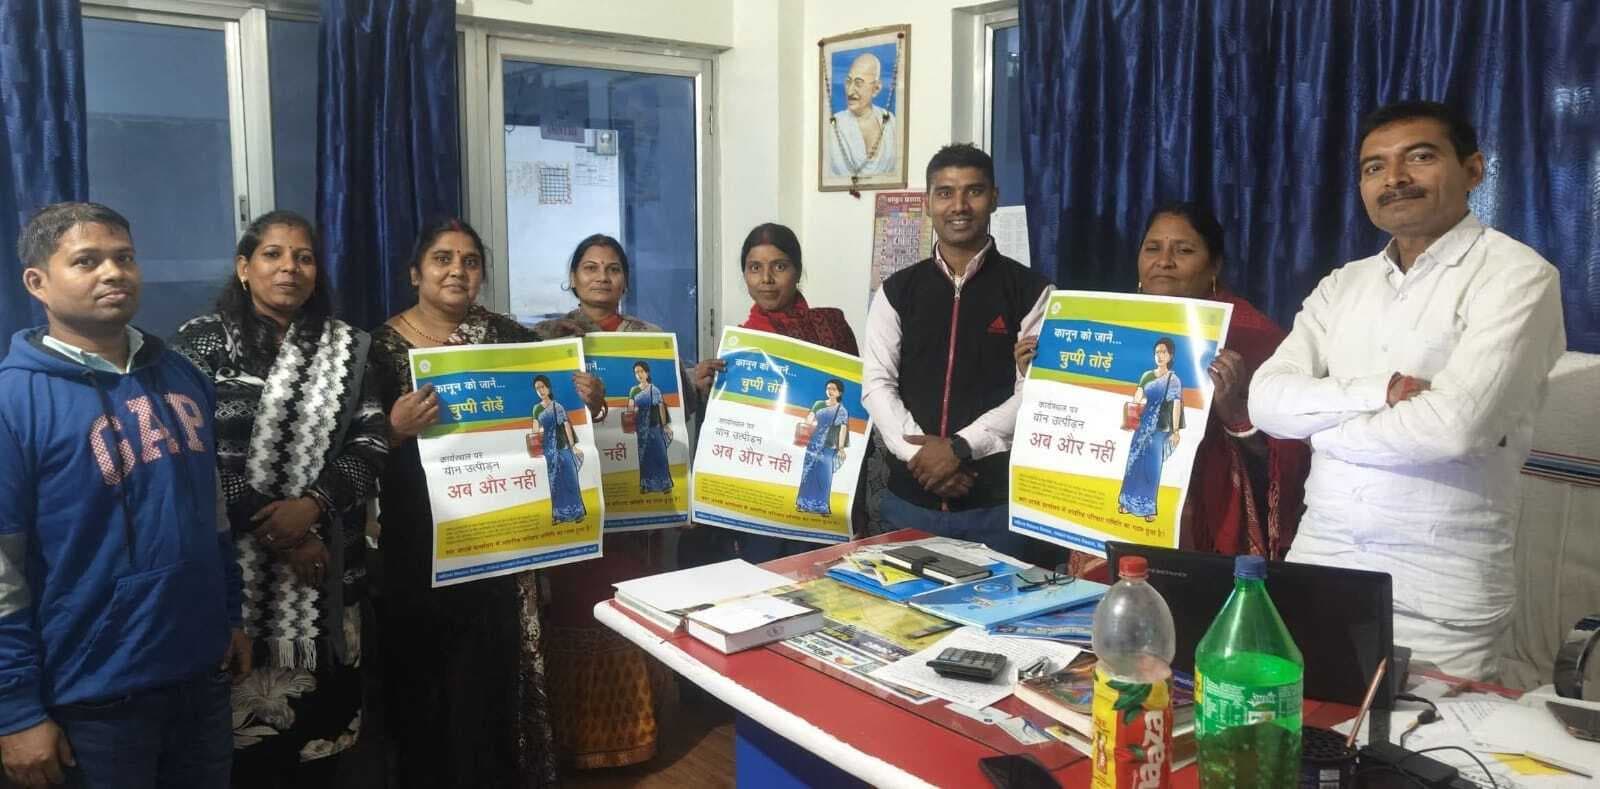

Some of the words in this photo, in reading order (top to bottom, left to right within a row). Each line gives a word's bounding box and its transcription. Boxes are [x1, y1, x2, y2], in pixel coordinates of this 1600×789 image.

[1054, 327, 1077, 343] कानून
[1080, 328, 1094, 342] को
[735, 358, 757, 372] कानून
[1059, 348, 1085, 369] चुप्पी
[434, 379, 462, 395] कानून
[464, 379, 477, 391] को
[448, 398, 477, 420] चुप्पी
[90, 392, 207, 485] GAP
[1029, 432, 1052, 450] अब
[1057, 432, 1084, 456] और
[1090, 439, 1115, 462] नहीं
[712, 444, 733, 460] अब
[738, 446, 764, 466] और
[768, 453, 792, 473] नहीं
[448, 482, 472, 499] अब
[479, 474, 507, 494] और
[511, 469, 537, 489] नहीं
